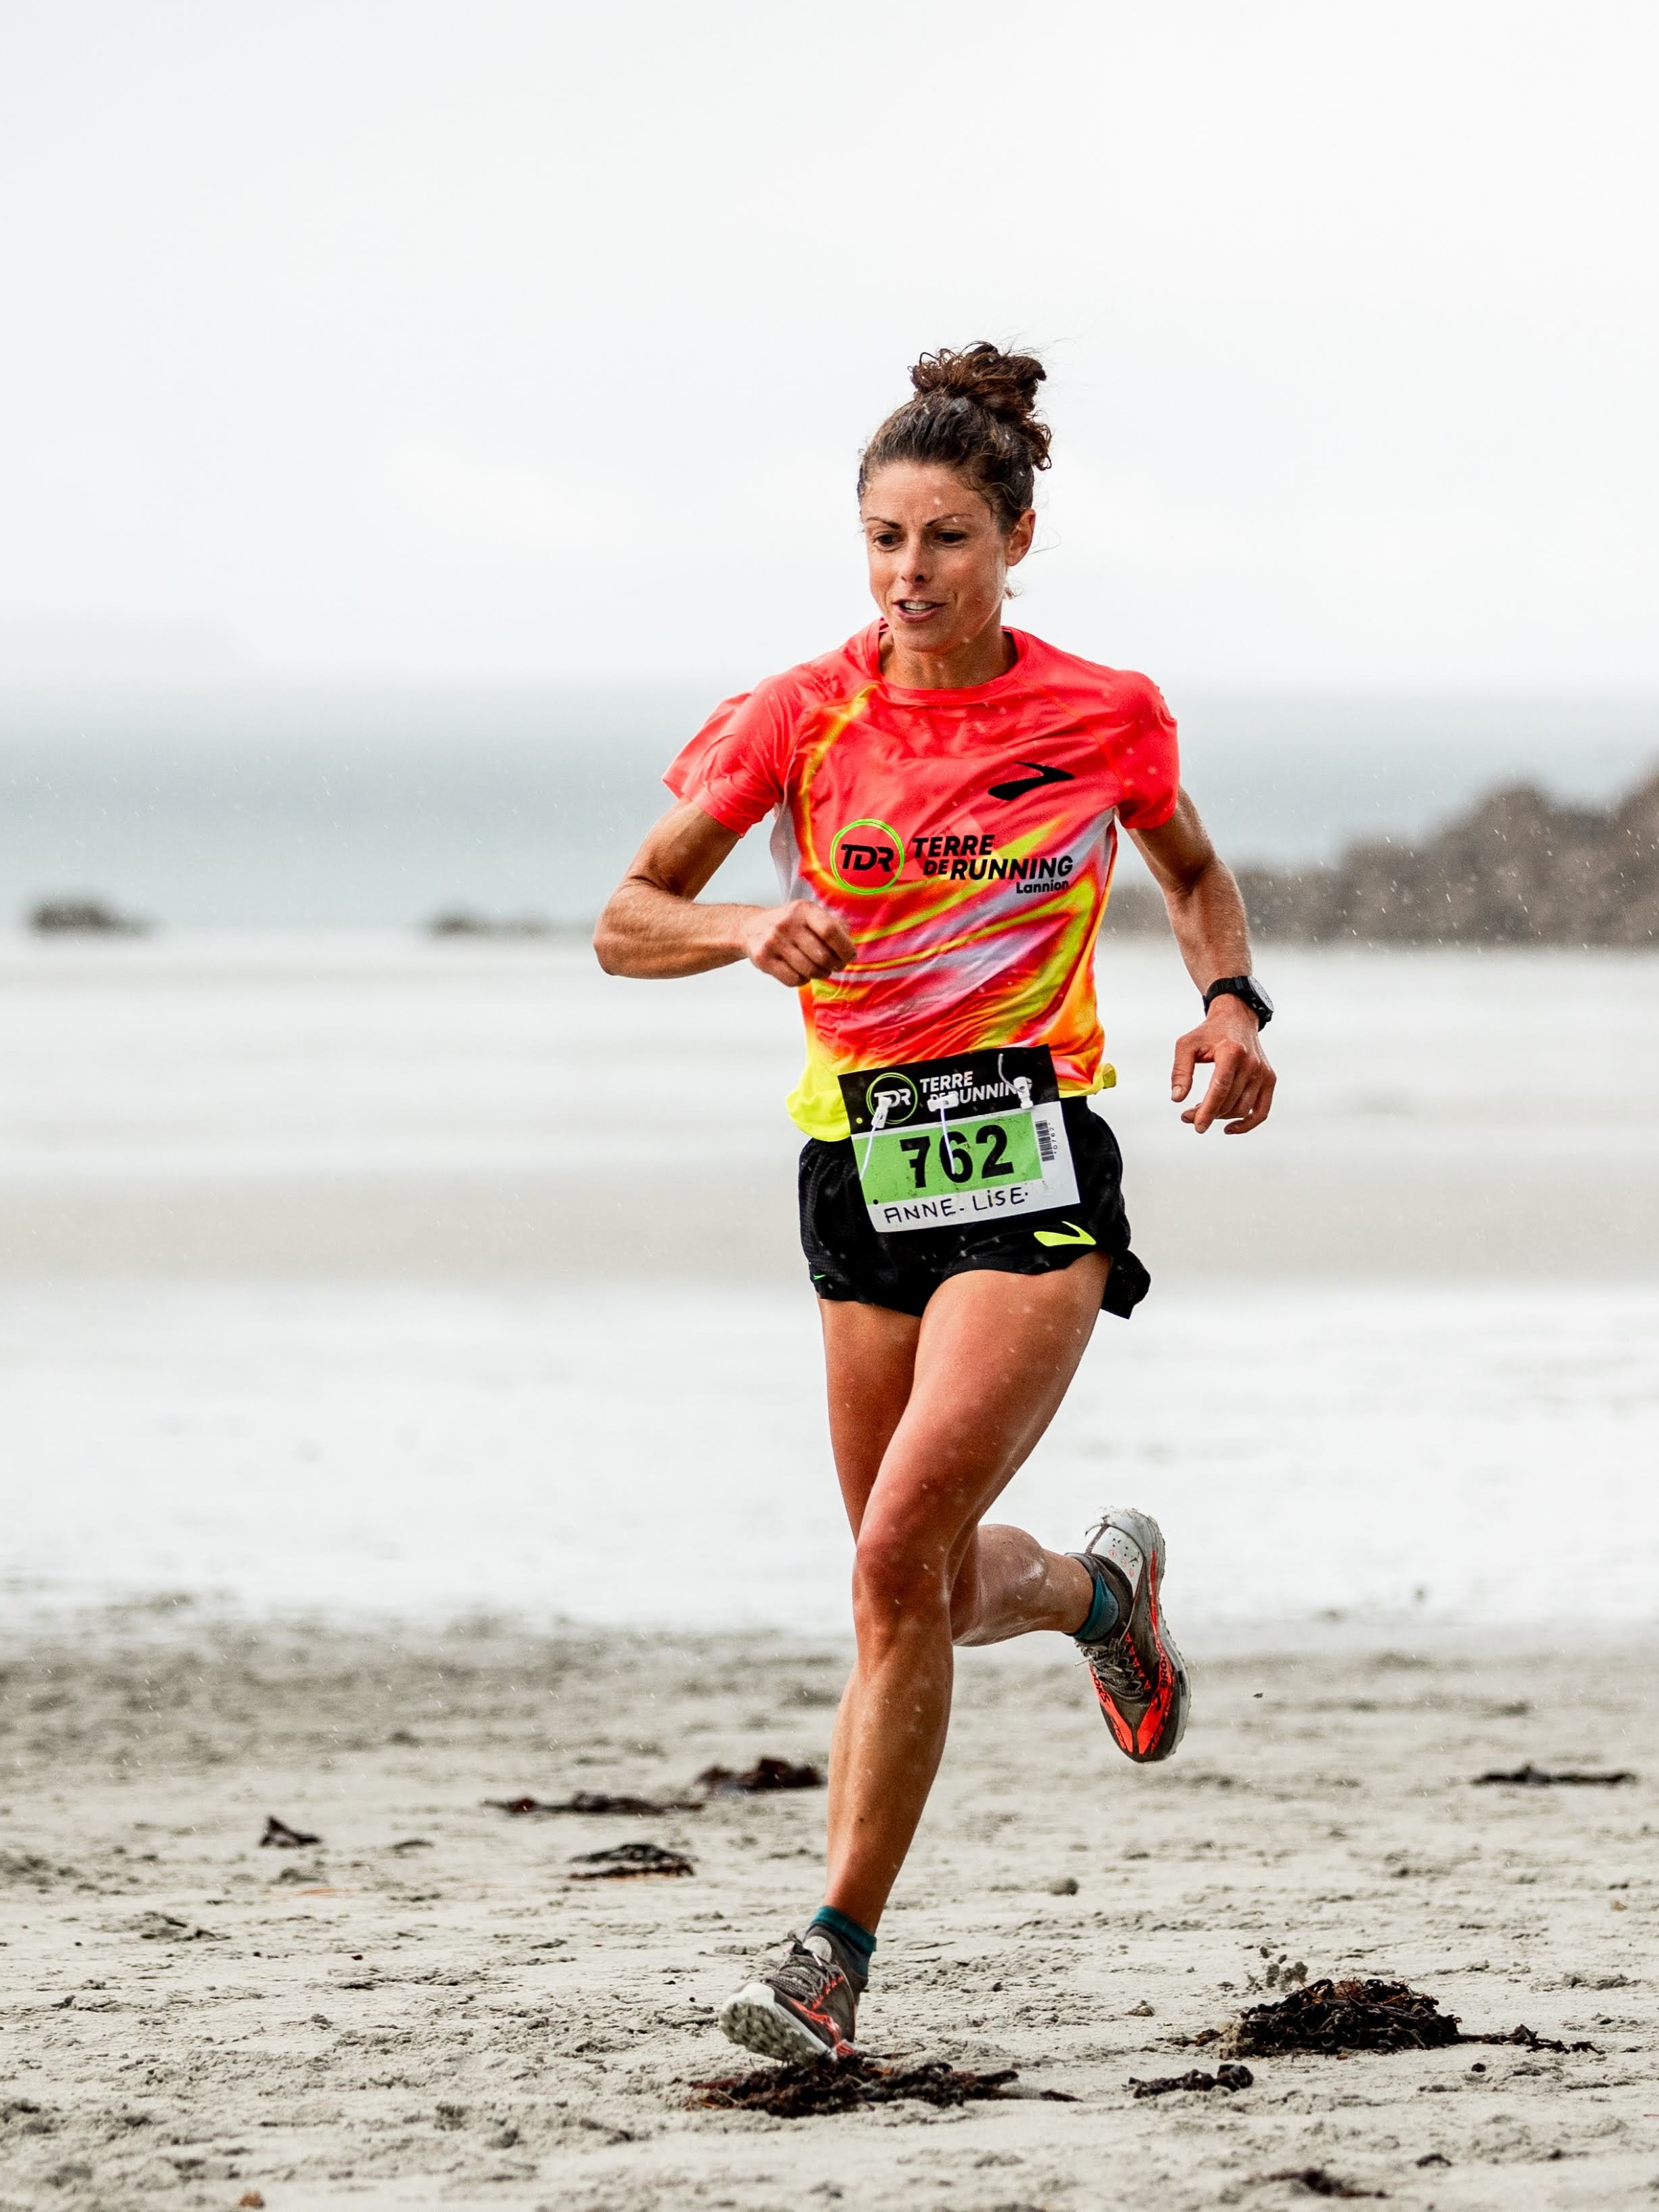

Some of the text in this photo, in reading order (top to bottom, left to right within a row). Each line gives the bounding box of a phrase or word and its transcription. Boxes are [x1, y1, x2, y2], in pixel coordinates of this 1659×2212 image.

[841, 843, 894, 873] TDR
[912, 834, 995, 859] TERRE
[923, 855, 1073, 880] DE RUNNING
[1016, 879, 1069, 894] Lannion
[919, 1071, 973, 1093] TERRE
[948, 1077, 1032, 1107] UNNIN
[900, 1124, 1014, 1189] 762
